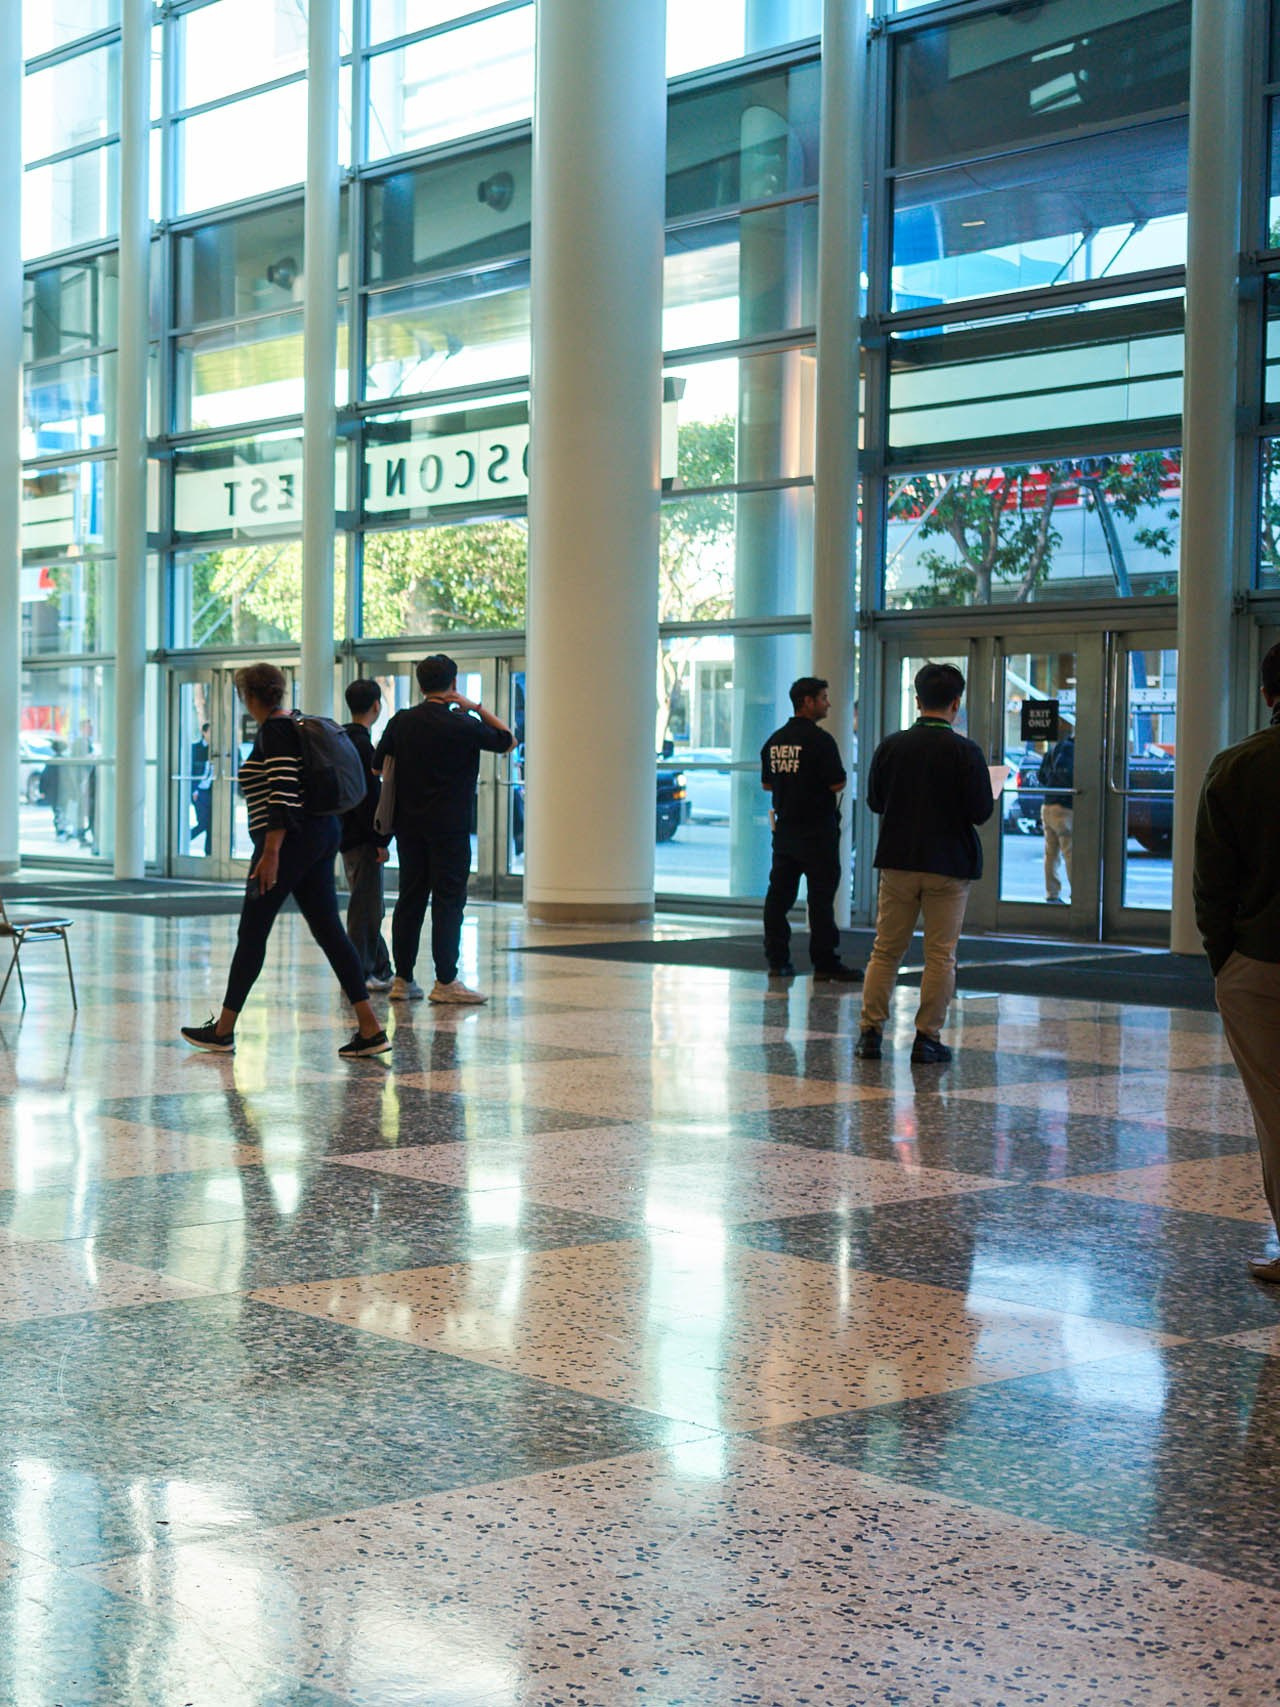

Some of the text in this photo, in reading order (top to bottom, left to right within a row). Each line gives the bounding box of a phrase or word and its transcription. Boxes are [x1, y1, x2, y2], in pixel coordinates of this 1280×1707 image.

[1029, 709, 1051, 718] EXIT
[1028, 719, 1052, 728] ONLY
[770, 744, 803, 760] EVENT
[770, 759, 800, 774] STAFF
